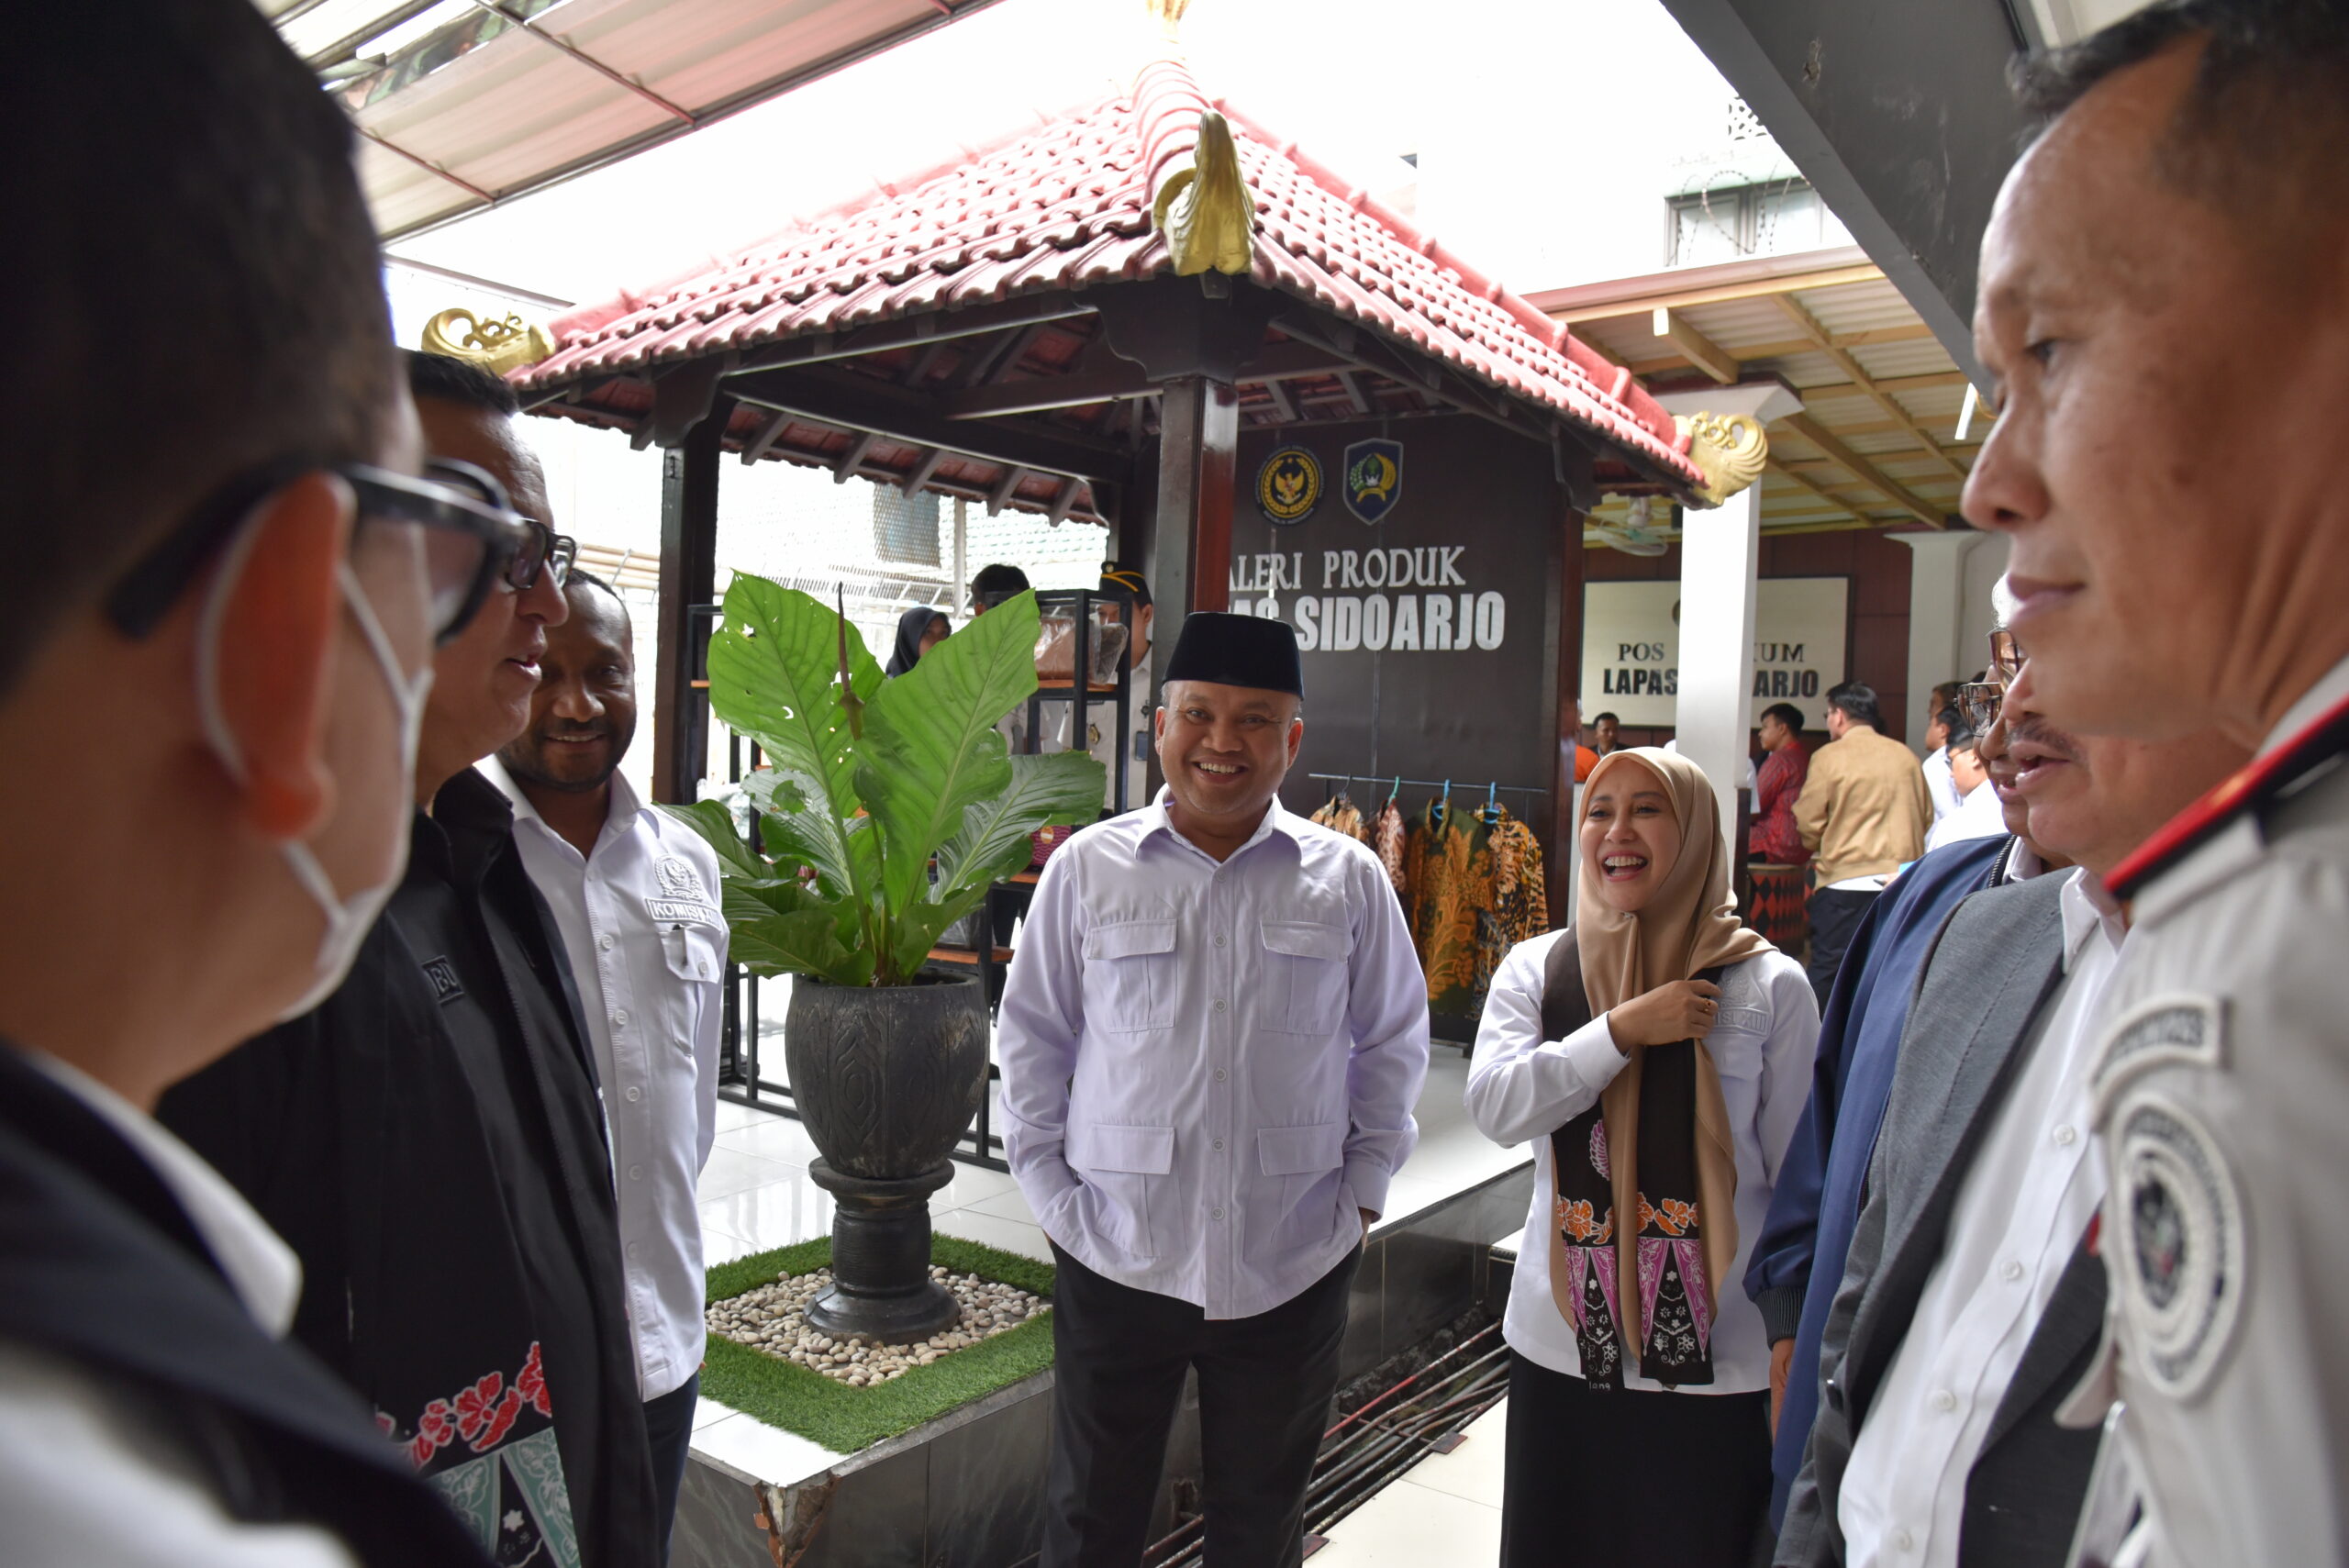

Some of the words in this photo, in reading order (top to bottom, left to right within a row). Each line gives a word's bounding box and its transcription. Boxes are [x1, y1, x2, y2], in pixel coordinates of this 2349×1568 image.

[1323, 546, 1465, 589] PRODUK
[1295, 591, 1505, 651] SIDOARJO
[1617, 641, 1665, 662] POS
[1753, 642, 1806, 663] UM
[1602, 667, 1678, 696] LAPAS
